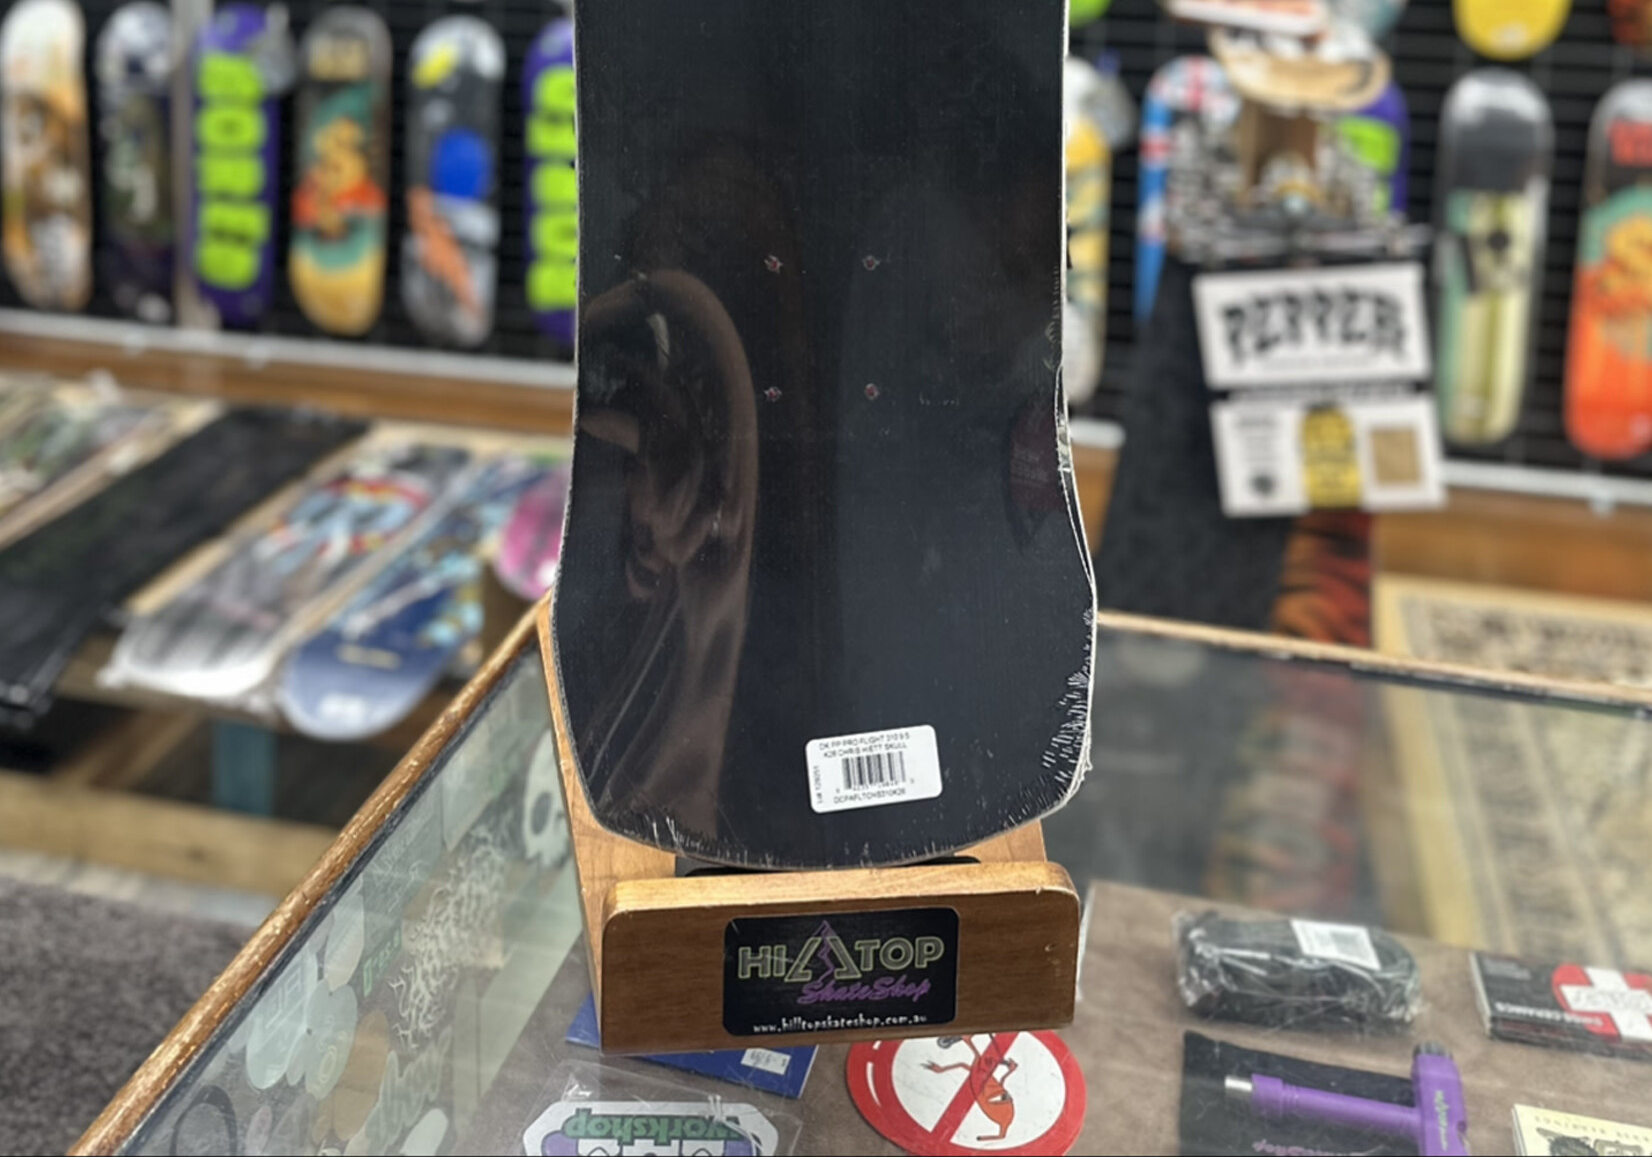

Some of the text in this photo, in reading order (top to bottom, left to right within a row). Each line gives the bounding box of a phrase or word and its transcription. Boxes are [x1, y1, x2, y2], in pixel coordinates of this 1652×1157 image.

[197, 53, 272, 287] BORED
[1223, 287, 1407, 364] PEPPER
[753, 1013, 927, 1033] www.hilltopskateshop.com.au
[564, 1108, 742, 1146] workshop
